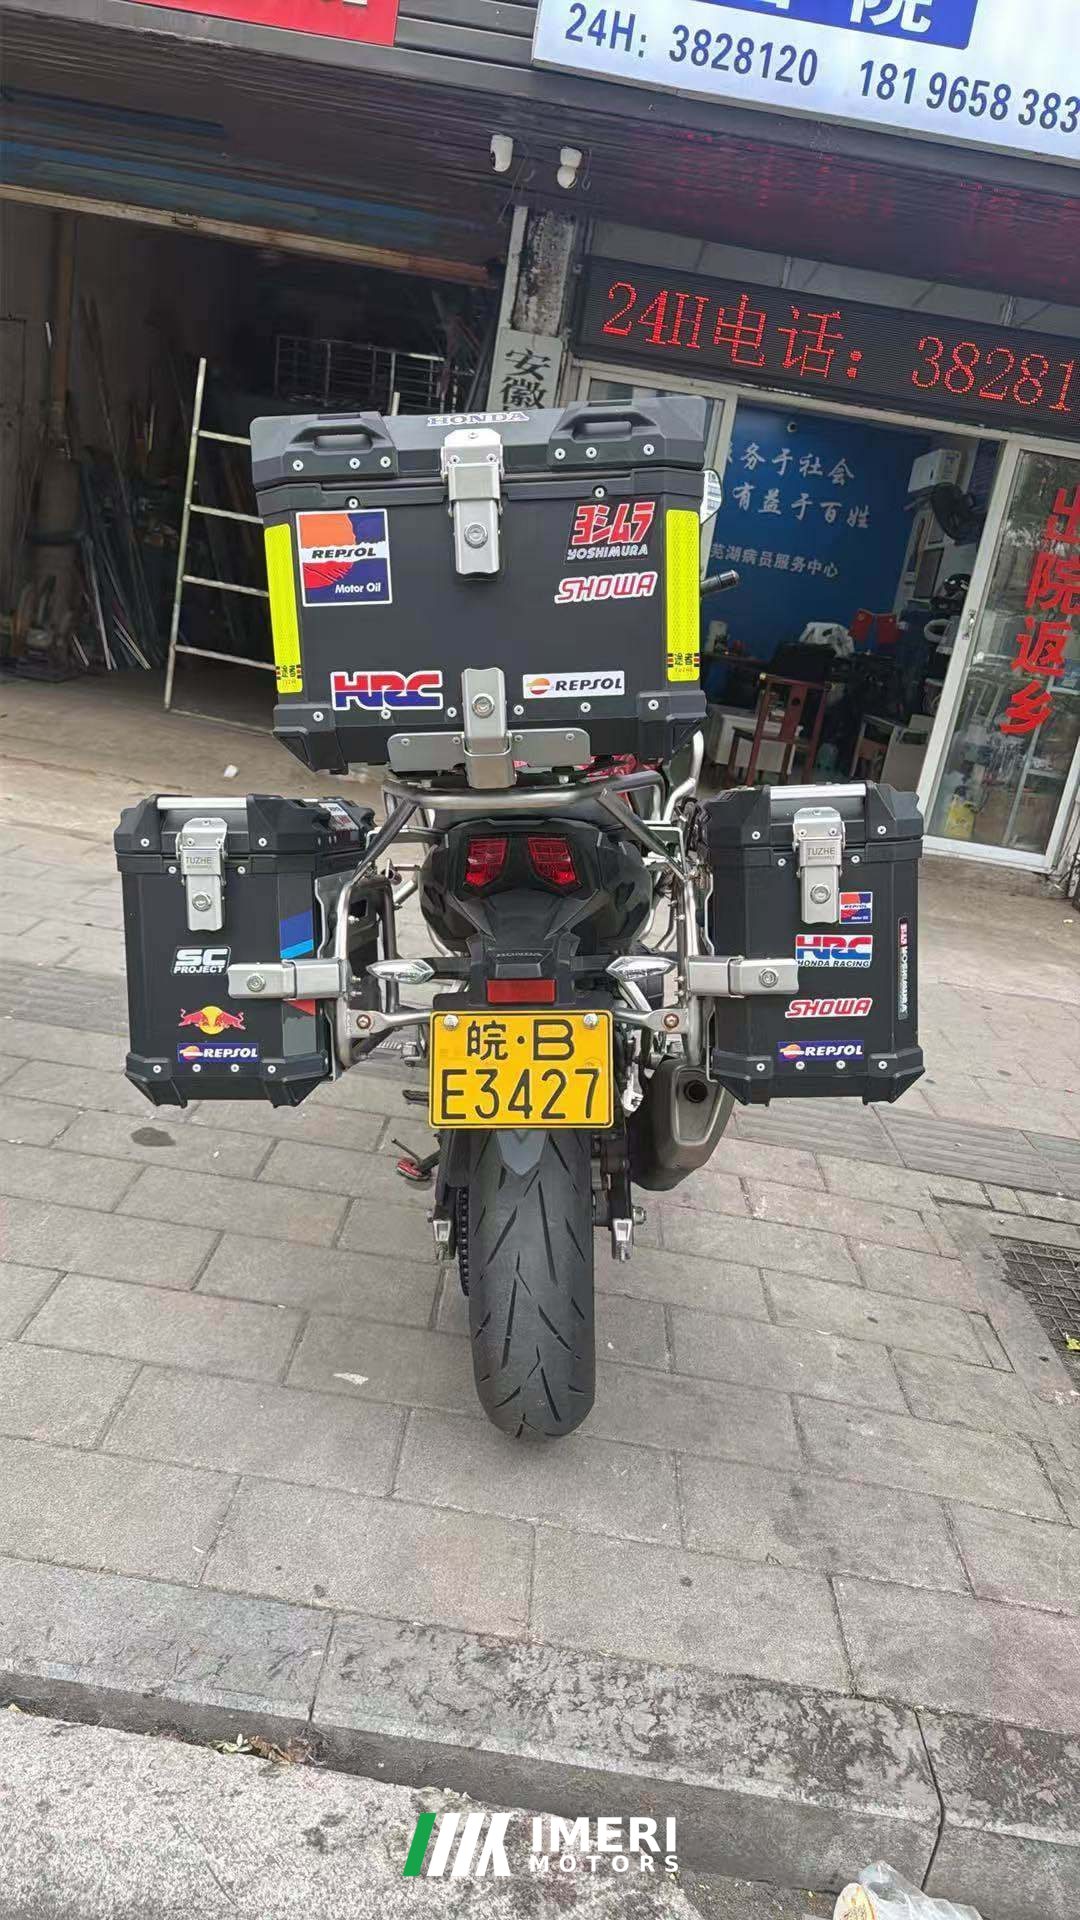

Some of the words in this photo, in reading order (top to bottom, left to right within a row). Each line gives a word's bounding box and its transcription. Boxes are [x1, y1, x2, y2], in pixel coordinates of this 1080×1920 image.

[565, 3, 647, 58] 24H:
[669, 25, 818, 86] 3828120
[499, 347, 552, 412] 安徽
[911, 336, 1074, 412] 38281
[427, 411, 530, 426] HONDA
[726, 441, 855, 486] 务于社会
[311, 547, 377, 559] REPSOL
[567, 544, 648, 561] YOSHIMURA
[334, 583, 364, 594] Motor
[366, 582, 381, 593] Oil
[554, 571, 658, 604] SHOWA
[330, 670, 443, 711] HRC
[555, 677, 622, 691] REPSOL
[796, 934, 872, 960] HRC
[174, 948, 229, 966] SC
[832, 960, 870, 968] RACING
[173, 965, 225, 974] PROJECT
[785, 998, 872, 1018] SHOWA
[203, 1047, 258, 1059] REPSOL
[804, 1045, 864, 1056] REPSOL
[441, 1069, 600, 1120] E3427
